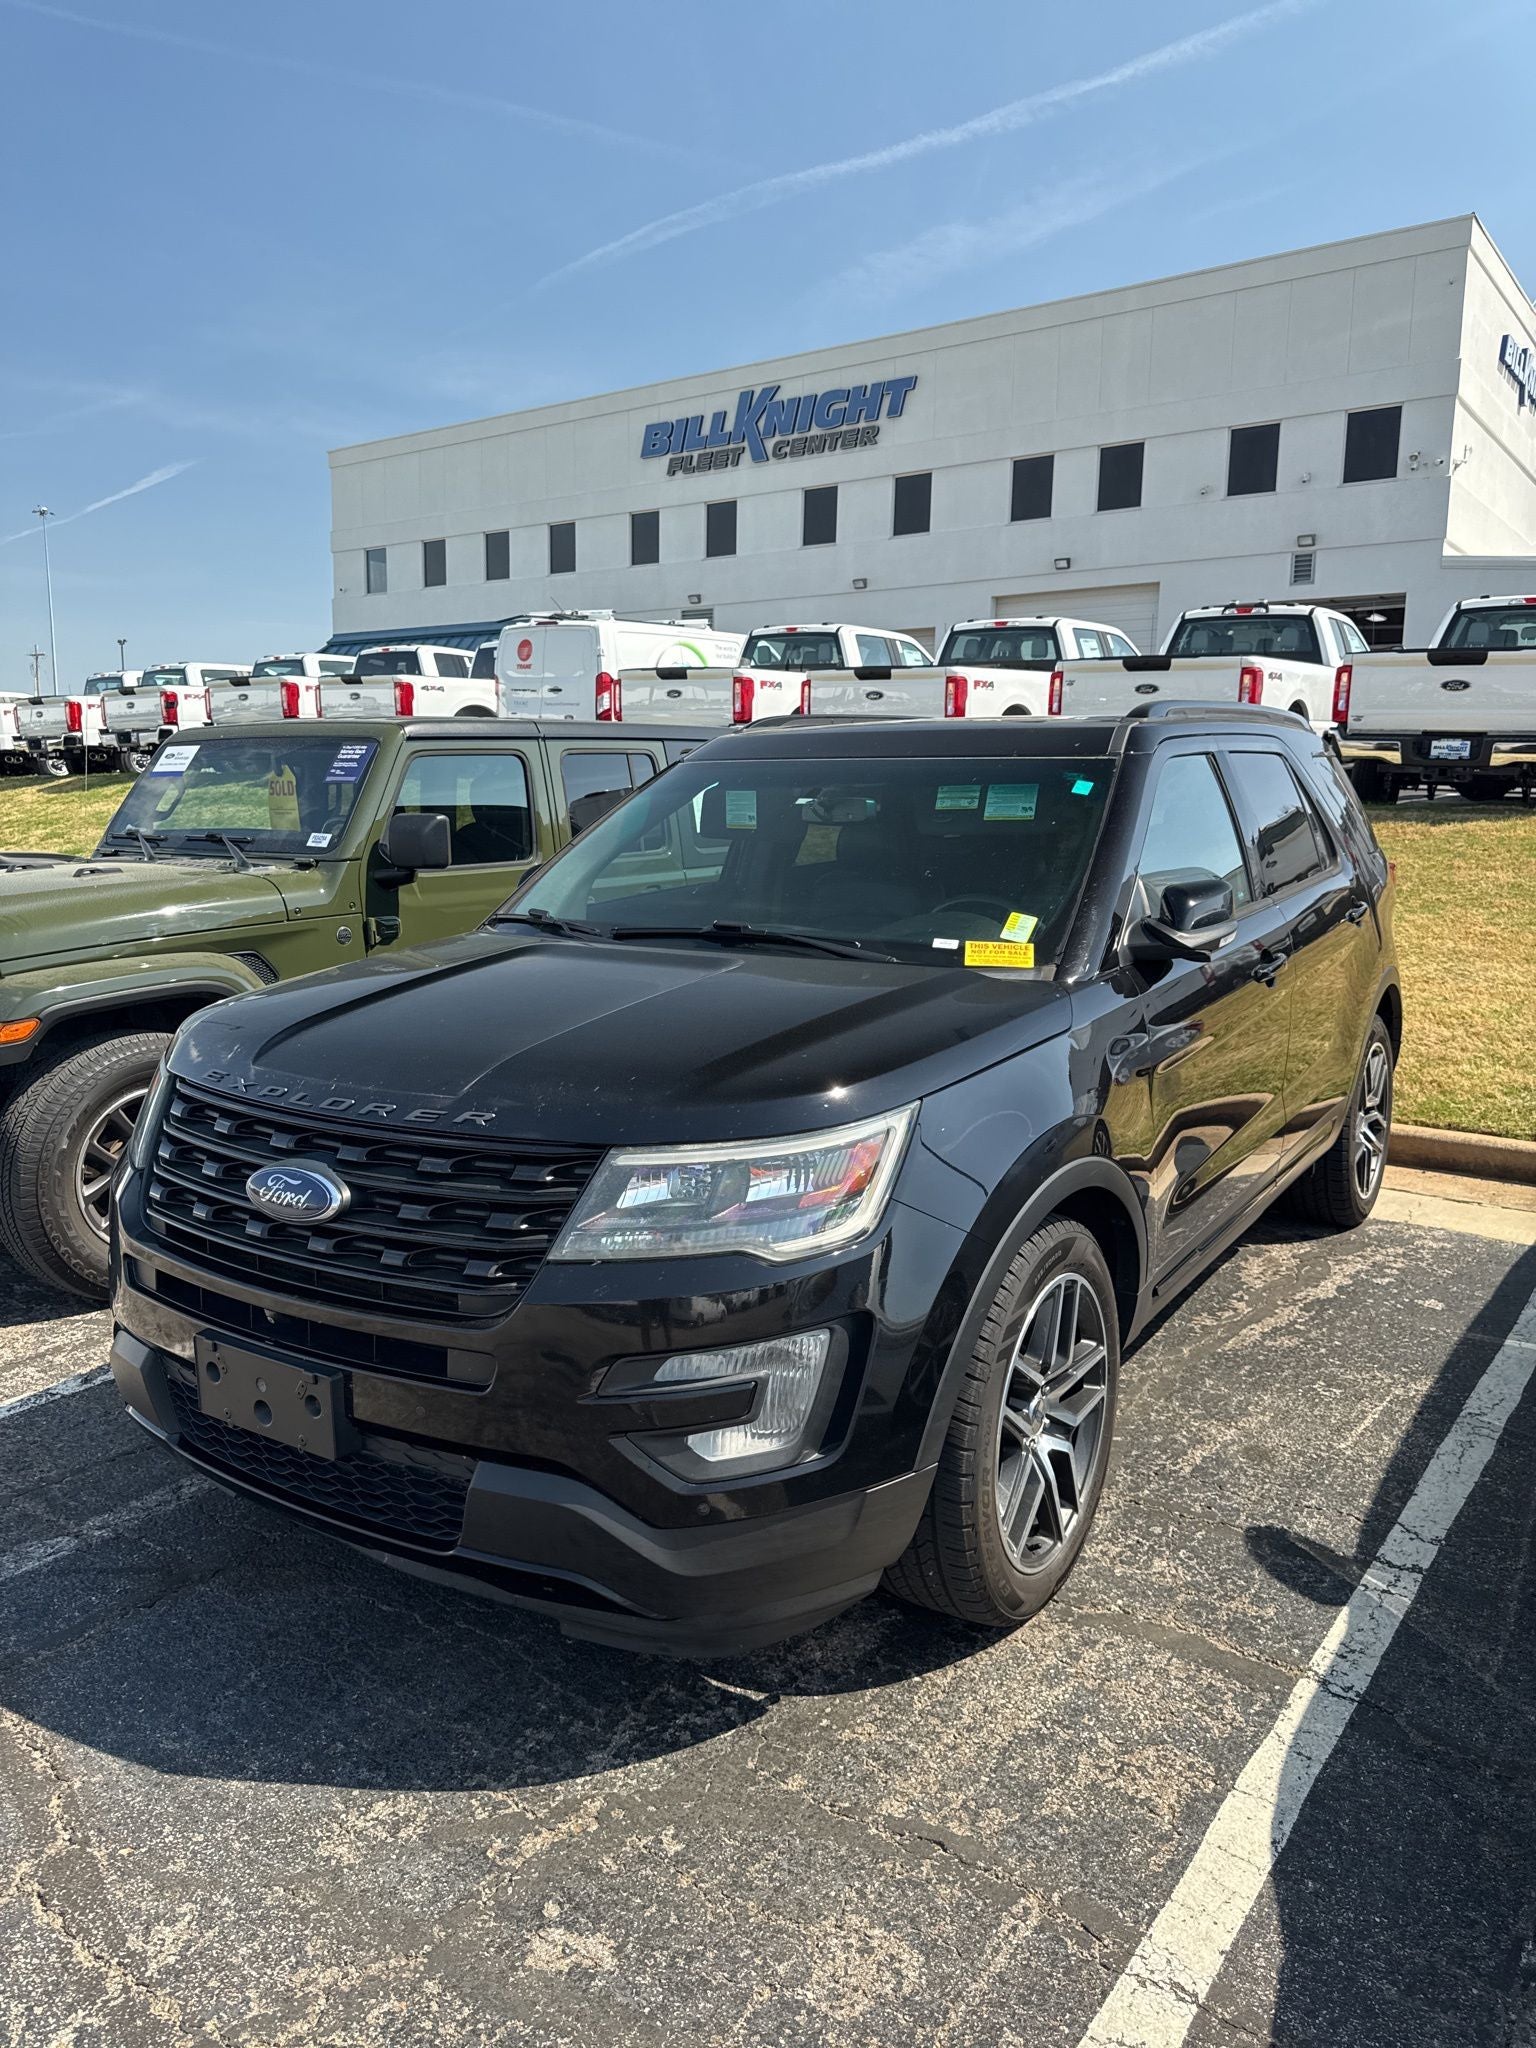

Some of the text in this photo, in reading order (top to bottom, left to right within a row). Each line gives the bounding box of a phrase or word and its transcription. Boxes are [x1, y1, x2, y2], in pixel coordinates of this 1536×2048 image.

[640, 375, 918, 463] BILL KNIGHT
[666, 425, 880, 476] FLEET CENTER
[760, 681, 783, 689] FX4
[974, 680, 995, 690] FX4
[269, 780, 295, 796] SOLD
[202, 1068, 496, 1125] EXPLORER
[259, 1173, 313, 1210] Ford
